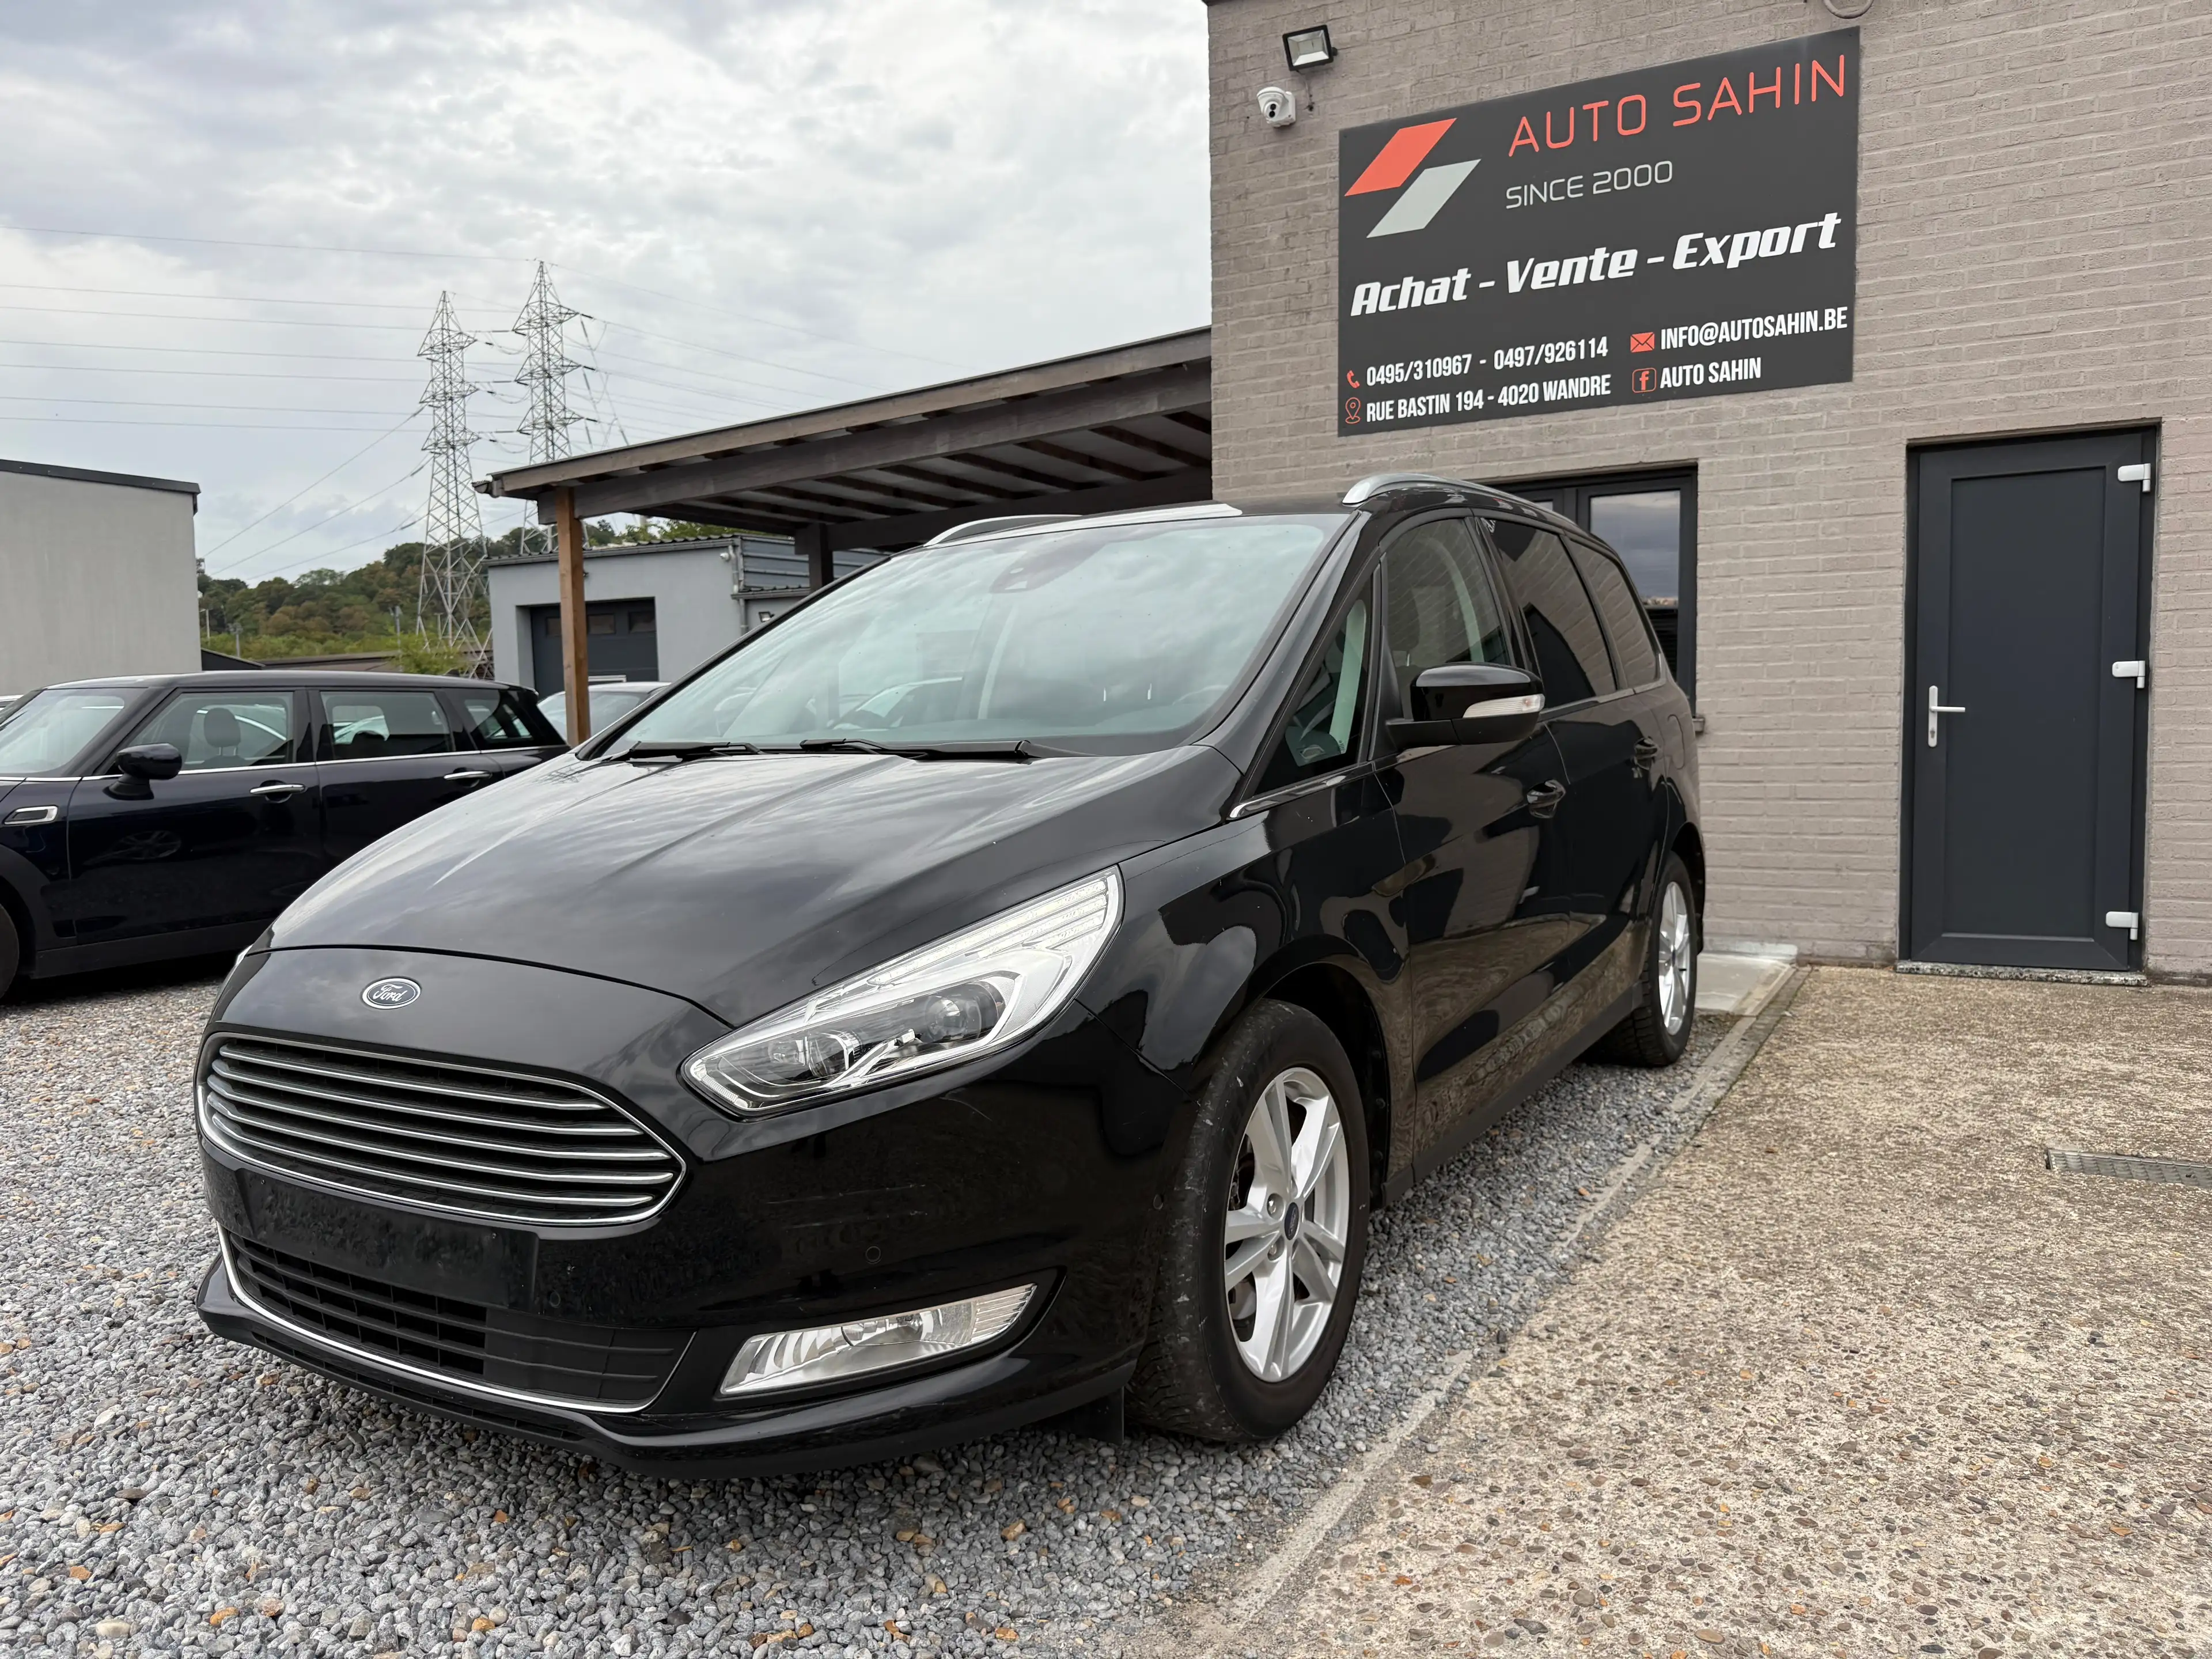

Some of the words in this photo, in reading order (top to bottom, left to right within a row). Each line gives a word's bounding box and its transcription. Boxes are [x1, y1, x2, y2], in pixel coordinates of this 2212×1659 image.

[1509, 94, 1646, 157] AUTO
[1673, 55, 1844, 127] SAHIN
[1506, 175, 1584, 209] SINCE
[1593, 161, 1673, 194] 2000
[1351, 268, 1472, 316] Achat
[1508, 247, 1638, 293] Vente
[1673, 213, 1841, 269] Export
[1661, 306, 1847, 350] INFO@AUTOSAHIN.BE
[1367, 354, 1472, 386] 0495/310967
[1494, 336, 1608, 370] 0497/926114
[1660, 362, 1705, 388] AUTO
[1709, 357, 1762, 383] SAHIN
[1367, 400, 1395, 422] RUE
[1398, 393, 1450, 419] BASTIN
[1456, 389, 1484, 411] 194
[1498, 382, 1539, 406] 4020
[1543, 374, 1611, 402] WANDRE
[373, 984, 408, 1002] Ford
